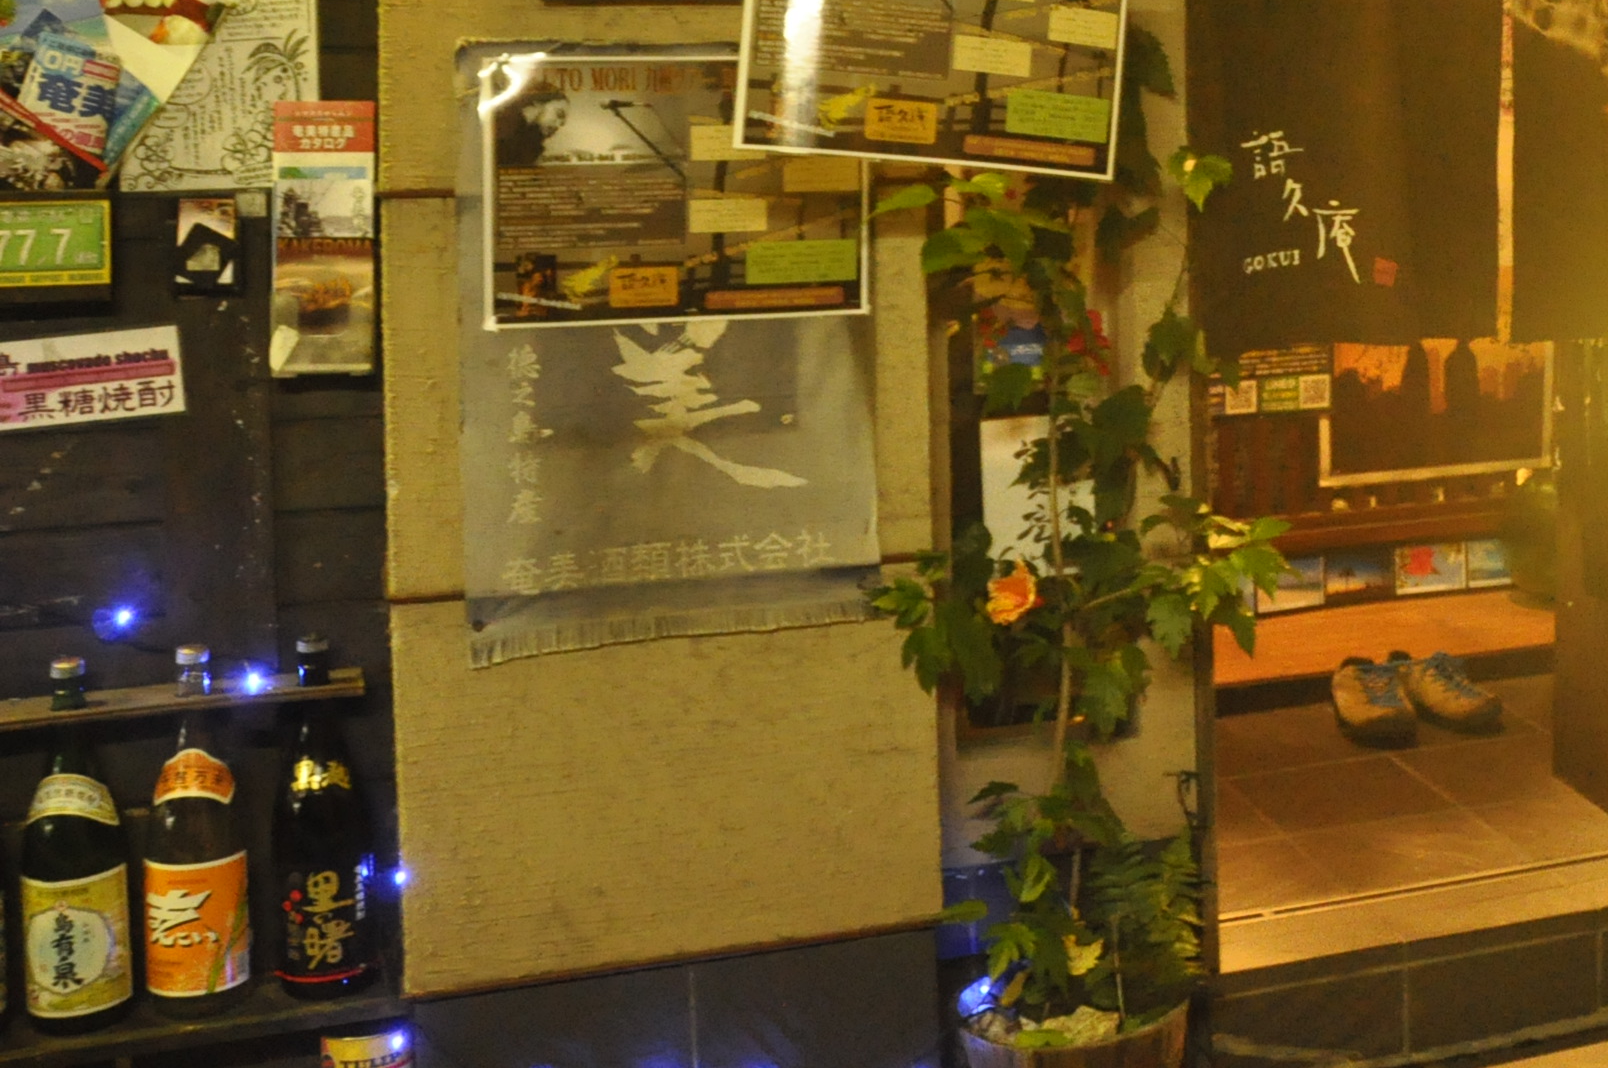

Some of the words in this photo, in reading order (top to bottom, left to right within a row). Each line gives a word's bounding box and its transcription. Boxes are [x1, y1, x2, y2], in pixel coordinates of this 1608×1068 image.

[559, 67, 584, 92] TO
[299, 138, 349, 150] カタログ
[1241, 131, 1361, 285] 語久庵
[1243, 249, 1301, 274] GOKUI
[17, 379, 176, 420] 黒糖焼酎
